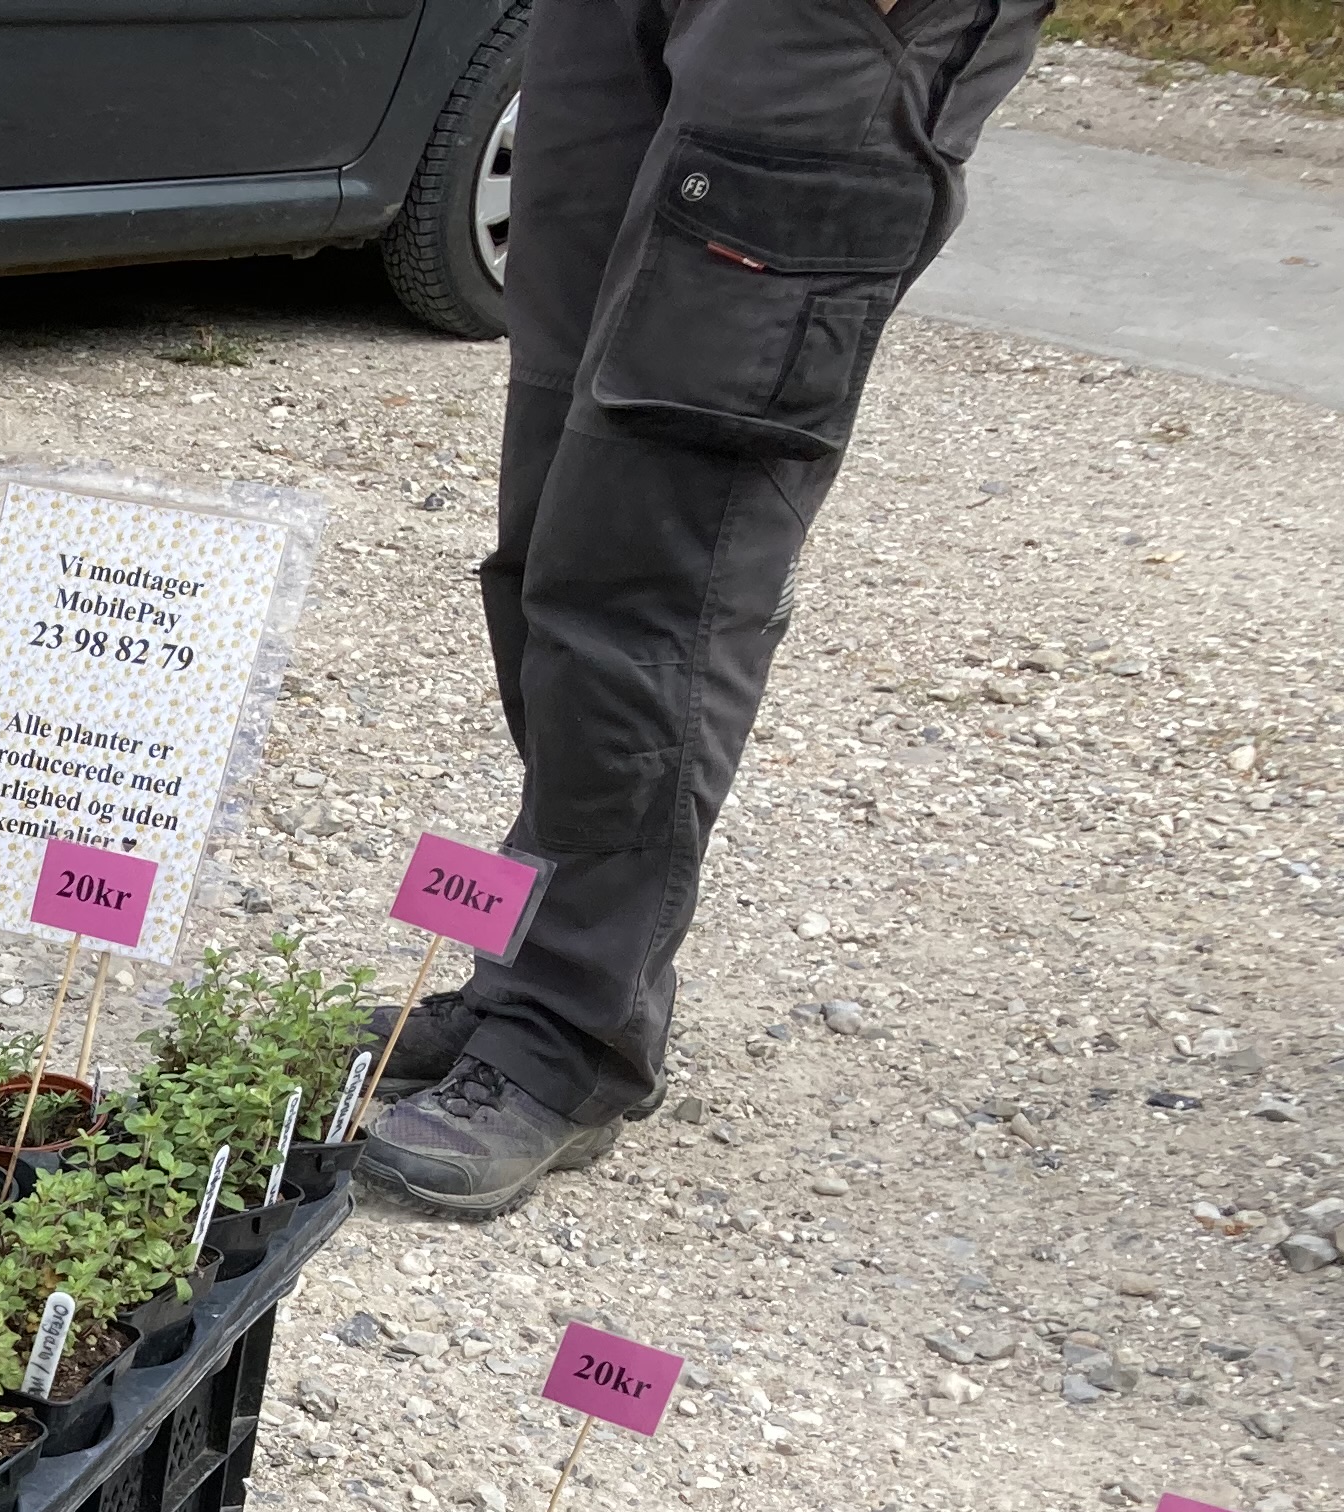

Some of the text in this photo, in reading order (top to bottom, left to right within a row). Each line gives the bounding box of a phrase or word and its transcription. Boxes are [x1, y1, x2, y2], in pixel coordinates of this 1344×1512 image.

[684, 178, 707, 198] FE
[58, 553, 205, 600] Vi modtager
[54, 587, 183, 634] MobilePay
[30, 621, 196, 673] 23 98 82 79
[5, 712, 174, 761] Alle planter er
[131, 771, 182, 797] med
[88, 797, 115, 823] og
[122, 803, 179, 832] uden
[55, 869, 133, 911] 20kr
[422, 867, 503, 916] 20kr
[334, 1061, 365, 1140] Origanum
[572, 1354, 652, 1399] 20kr
